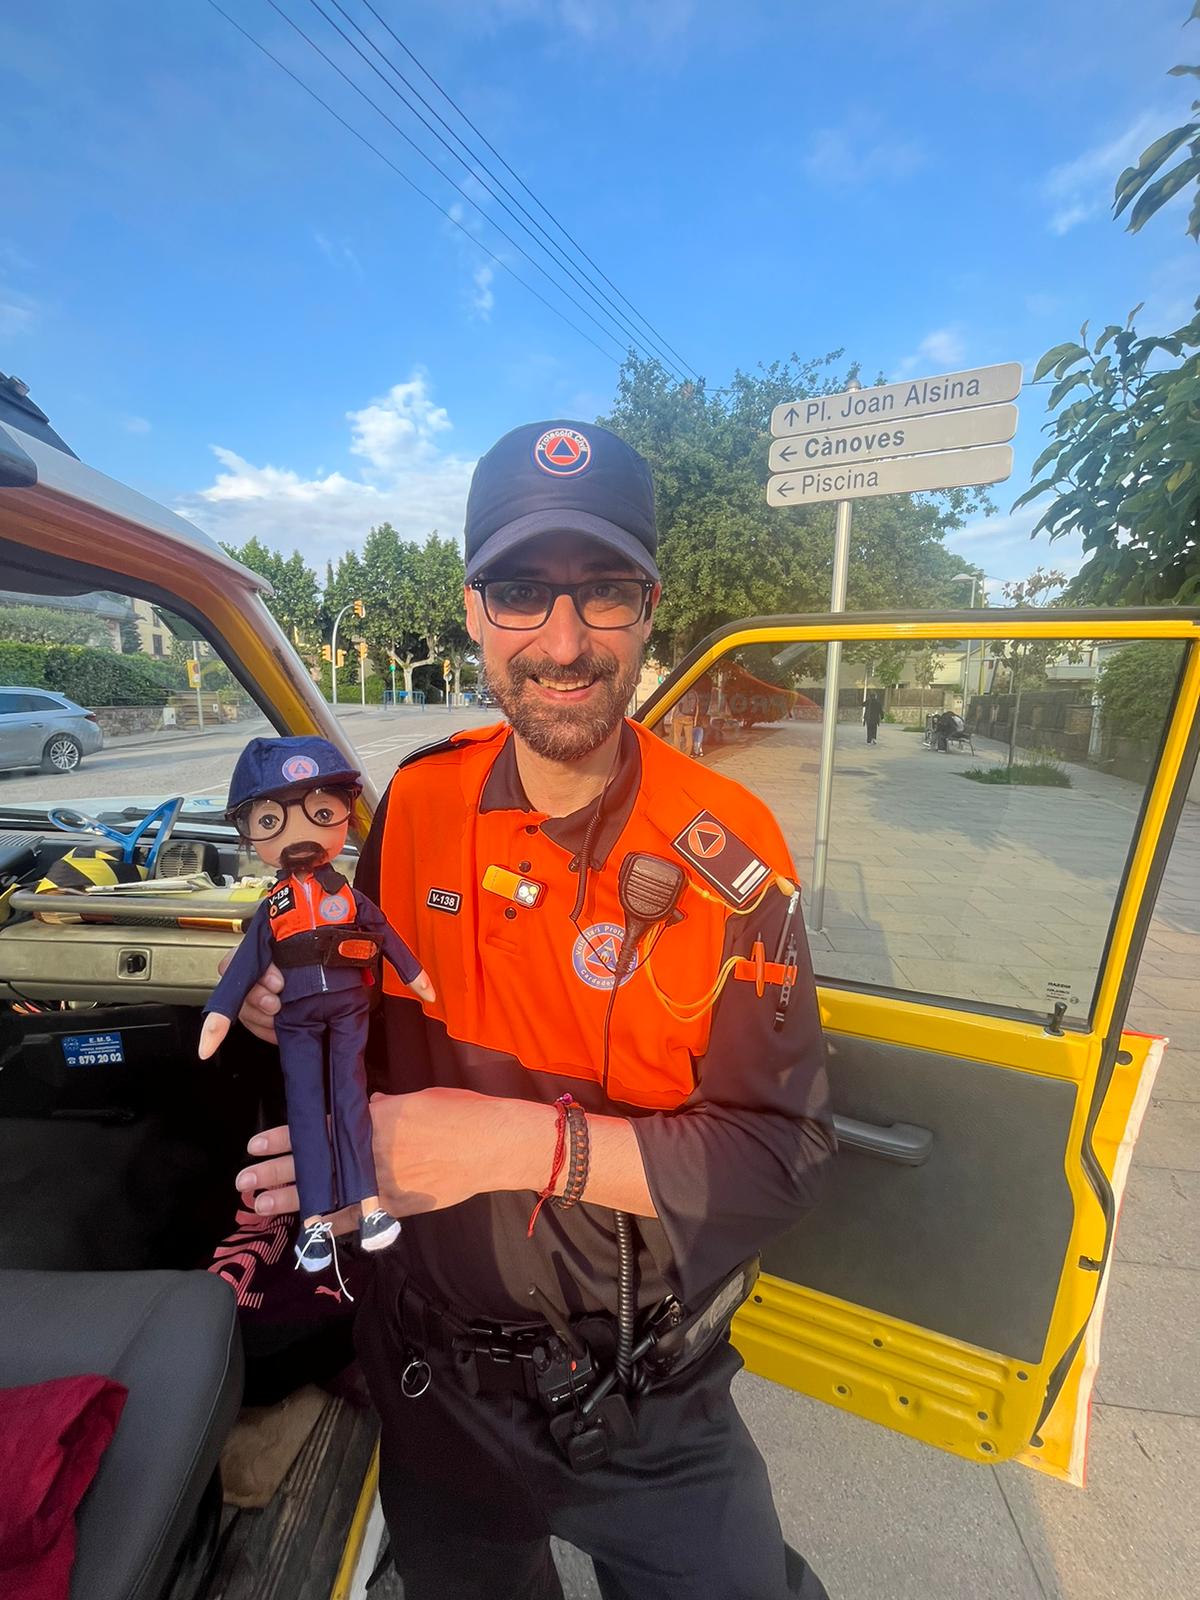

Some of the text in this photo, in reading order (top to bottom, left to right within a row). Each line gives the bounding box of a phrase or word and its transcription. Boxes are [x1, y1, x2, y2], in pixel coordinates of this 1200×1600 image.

[806, 378, 980, 424] Pl. Joan Alsina
[805, 429, 905, 459] Cànoves
[802, 470, 879, 495] Piscina
[269, 887, 289, 905] V-138
[432, 893, 455, 906] V-138
[97, 1054, 109, 1063] 20
[110, 1052, 122, 1062] 02
